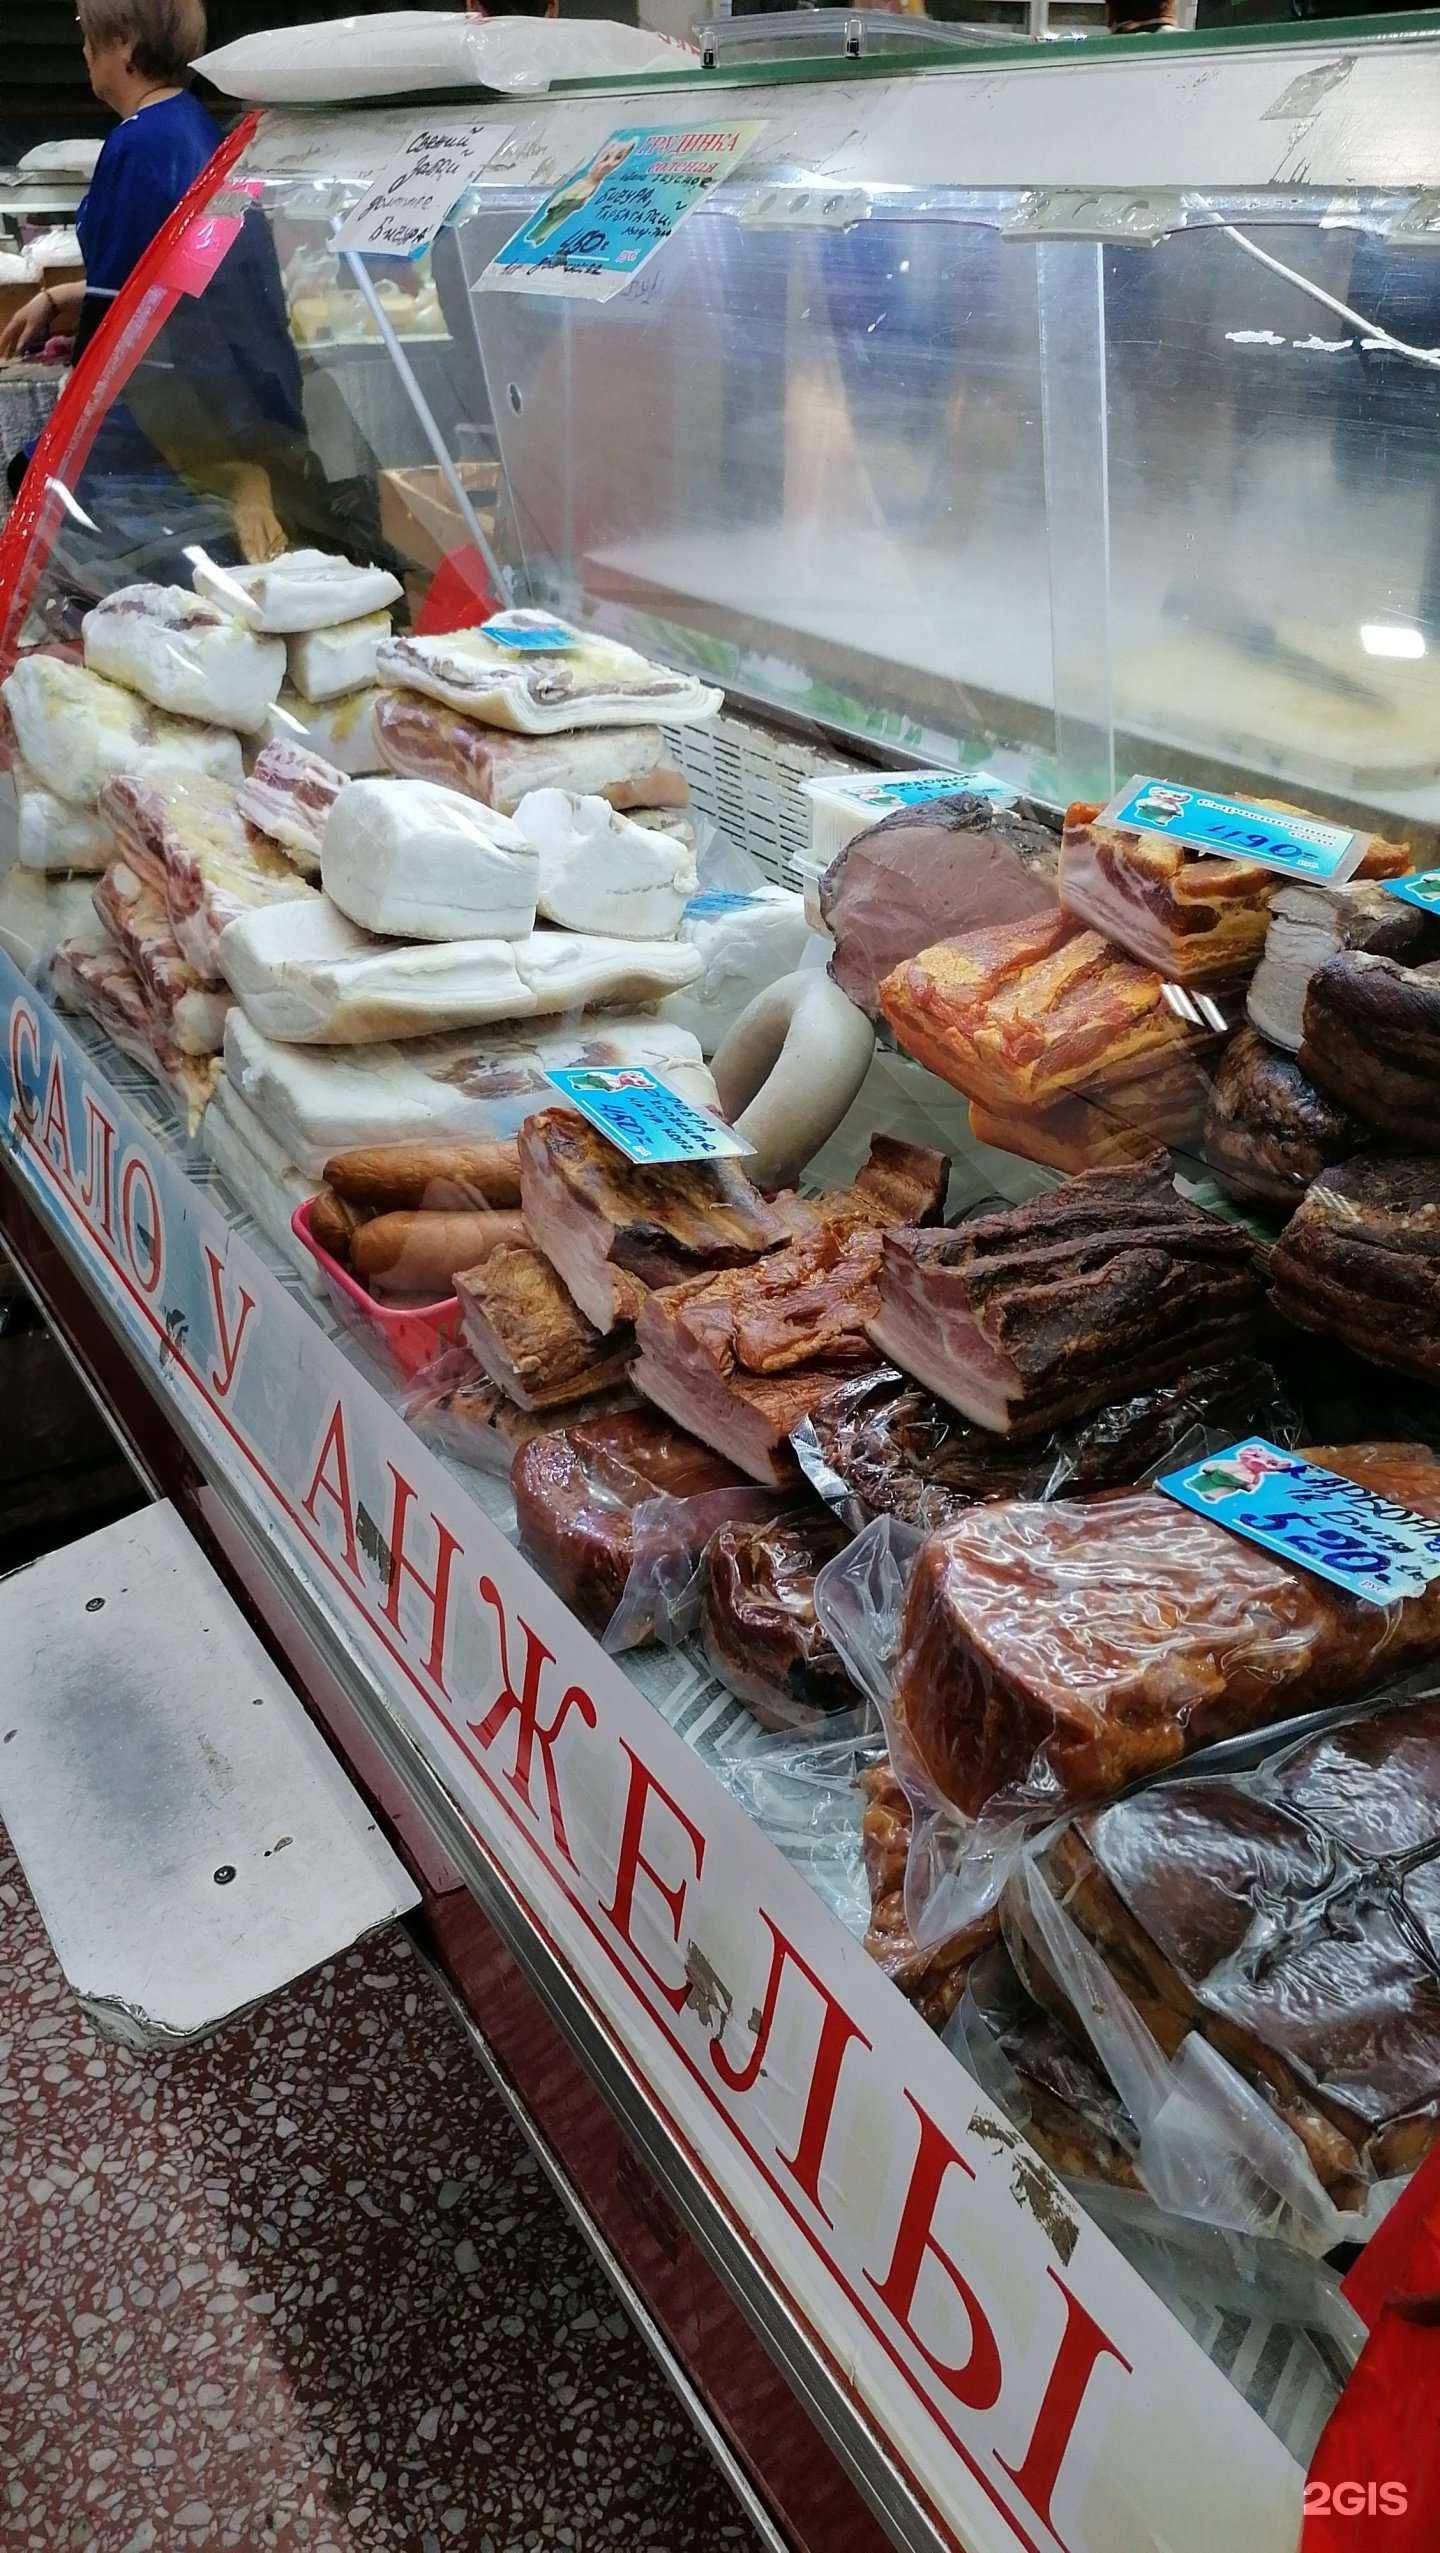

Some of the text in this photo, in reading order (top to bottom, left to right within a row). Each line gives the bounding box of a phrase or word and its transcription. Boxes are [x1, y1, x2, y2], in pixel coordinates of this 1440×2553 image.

[636, 132, 739, 155] ГРУДИНКА
[11, 1008, 1134, 2553] САЛО У АНЖЕЛЫ
